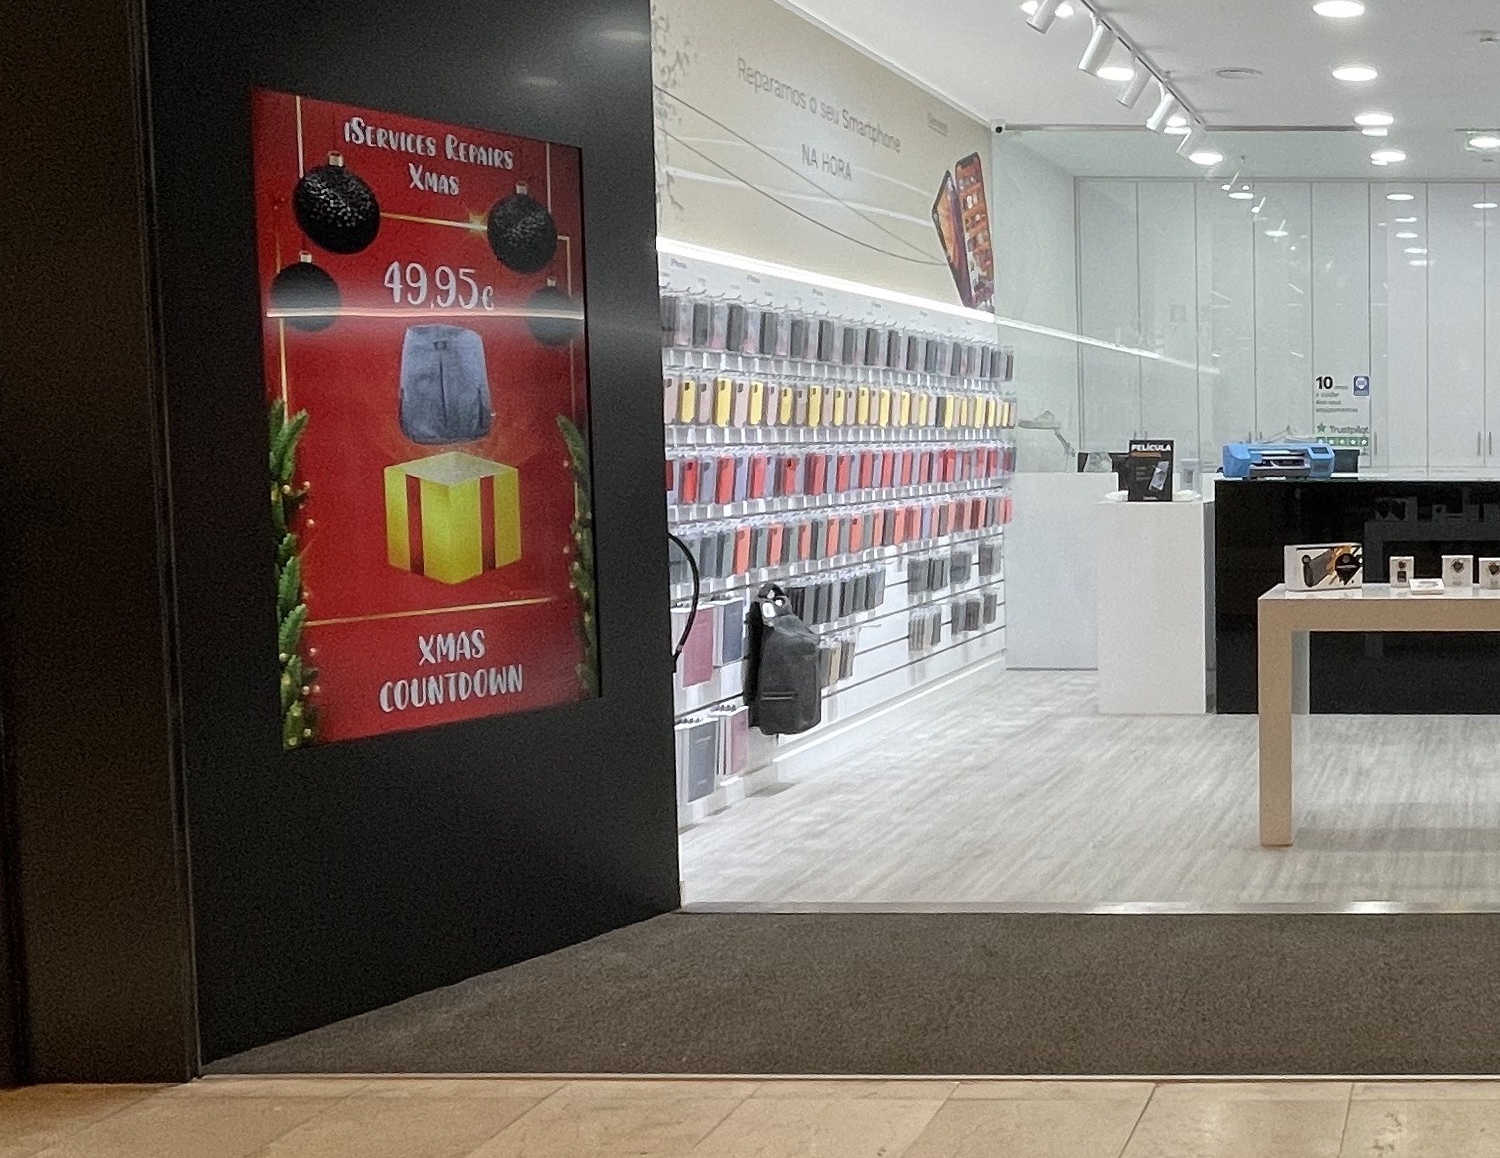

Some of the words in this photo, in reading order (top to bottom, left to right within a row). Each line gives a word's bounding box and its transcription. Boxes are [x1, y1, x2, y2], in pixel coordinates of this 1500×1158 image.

[737, 57, 806, 110] Reparamos
[809, 97, 817, 114] o
[820, 102, 839, 125] seu
[842, 108, 901, 154] Smartphone
[801, 143, 818, 169] NA
[822, 152, 852, 182] HORA
[1315, 376, 1333, 390] 10
[418, 629, 485, 666] XMAS
[379, 663, 523, 713] COUNTDOWN
